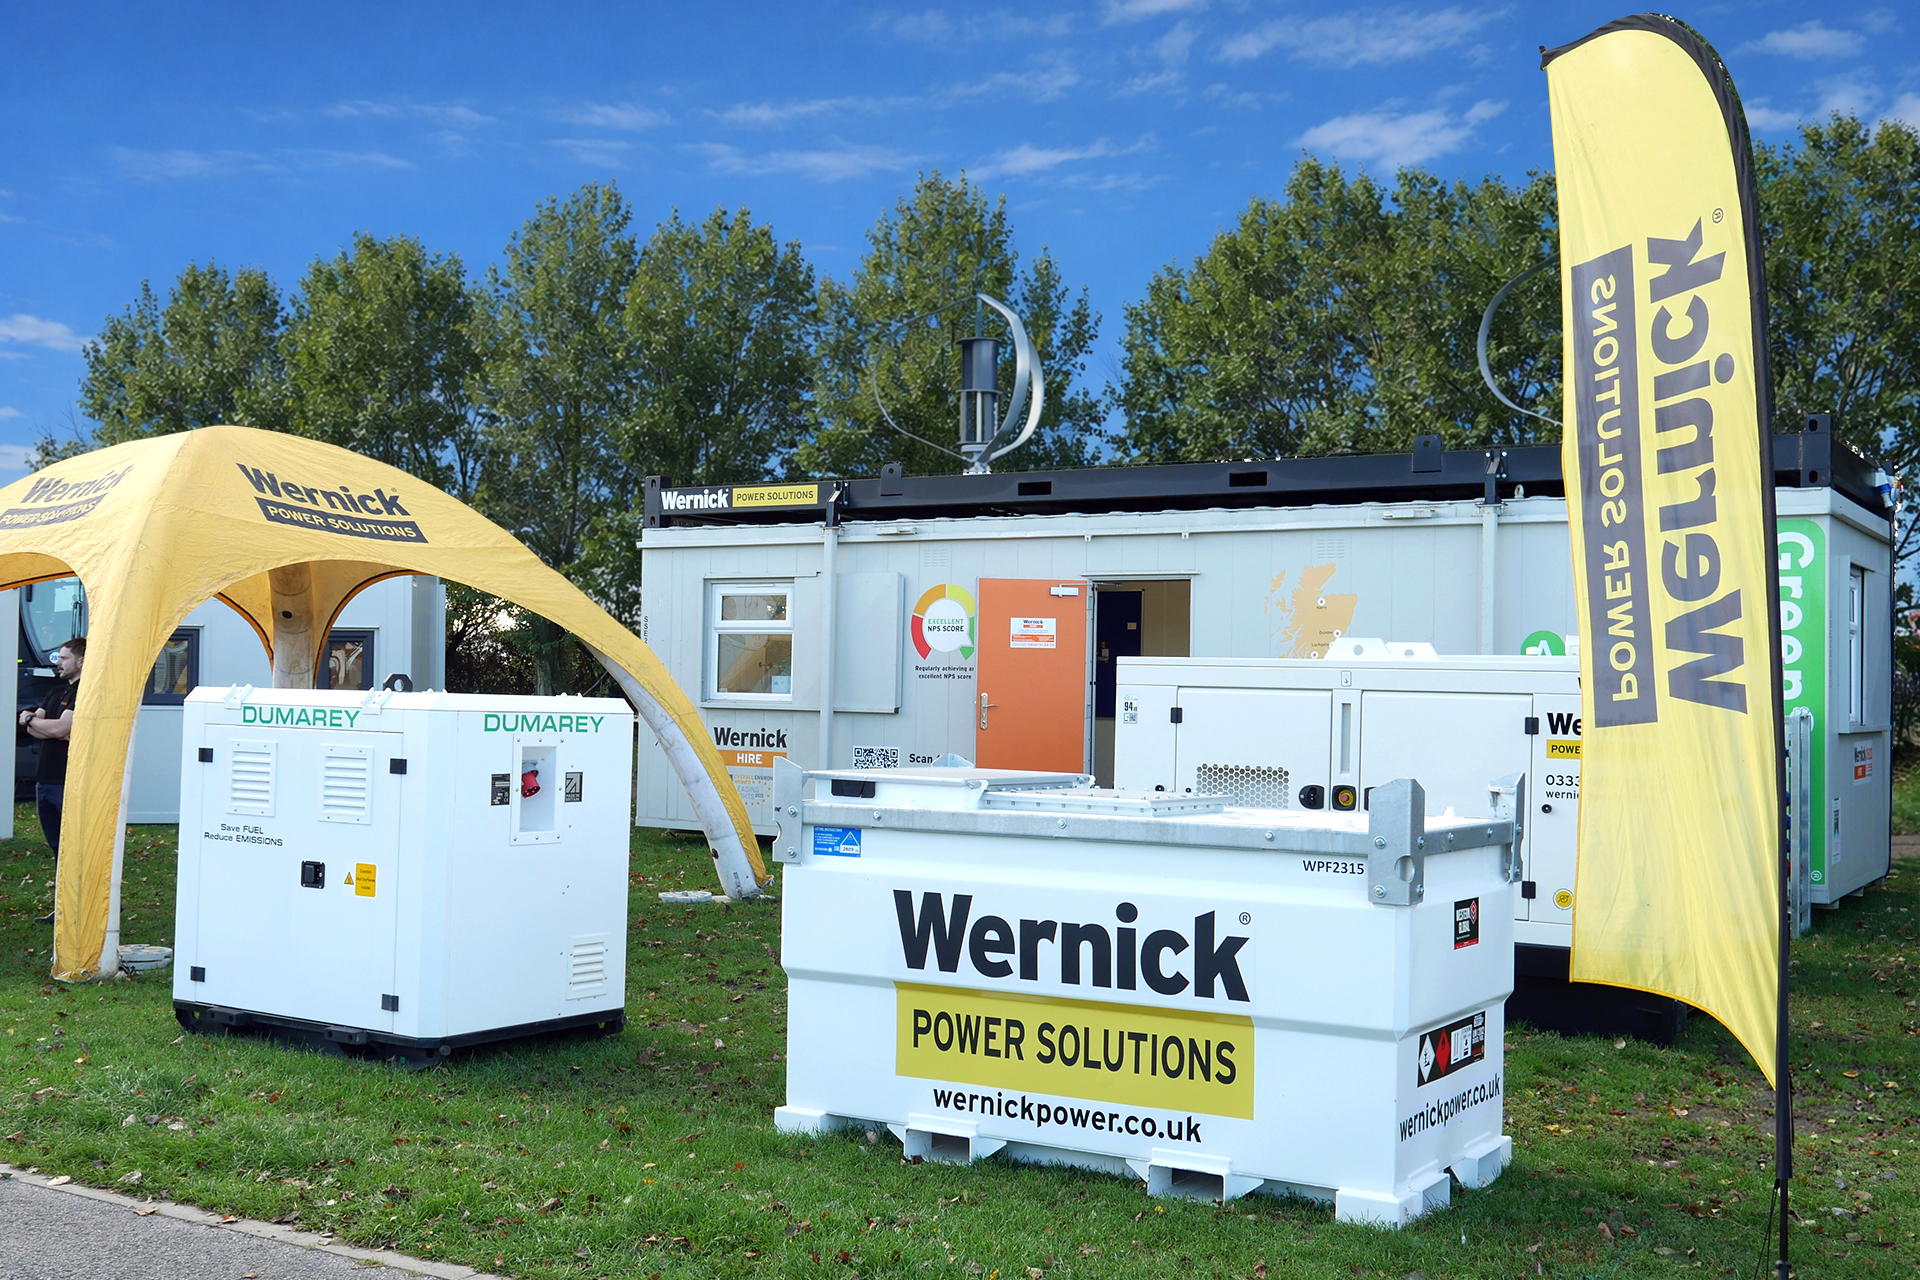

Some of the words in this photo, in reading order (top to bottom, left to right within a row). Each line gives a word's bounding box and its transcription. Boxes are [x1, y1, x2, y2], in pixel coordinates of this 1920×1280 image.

[20, 464, 134, 503] Wernick
[236, 463, 411, 517] Wernick
[661, 488, 729, 510] Wernick
[737, 493, 764, 501] POWER
[767, 490, 813, 501] SOLUTIONS
[2, 513, 40, 525] POWER
[37, 501, 98, 522] SOLUTIONS
[266, 505, 326, 527] POWER
[328, 518, 416, 538] SOLUTIONS
[242, 706, 360, 728] DUMAREY
[484, 714, 604, 733] DUMAREY
[1547, 712, 1582, 736] We
[713, 727, 787, 748] Wernick
[736, 753, 763, 764] HIRE
[909, 753, 933, 764] Scan
[1551, 744, 1580, 754] POWE
[204, 831, 233, 842] Reduce
[236, 834, 283, 846] EMISSIONS
[220, 823, 241, 833] Save
[243, 825, 264, 835] FUEL
[1302, 860, 1365, 875] WPF2315
[892, 889, 1251, 1003] Wernick
[913, 1009, 1025, 1061] POWER
[1036, 1021, 1236, 1085] SOLUTIONS
[933, 1088, 1203, 1144] wernickpower.co.uk
[1399, 1072, 1500, 1142] wernickpower.co.uk
